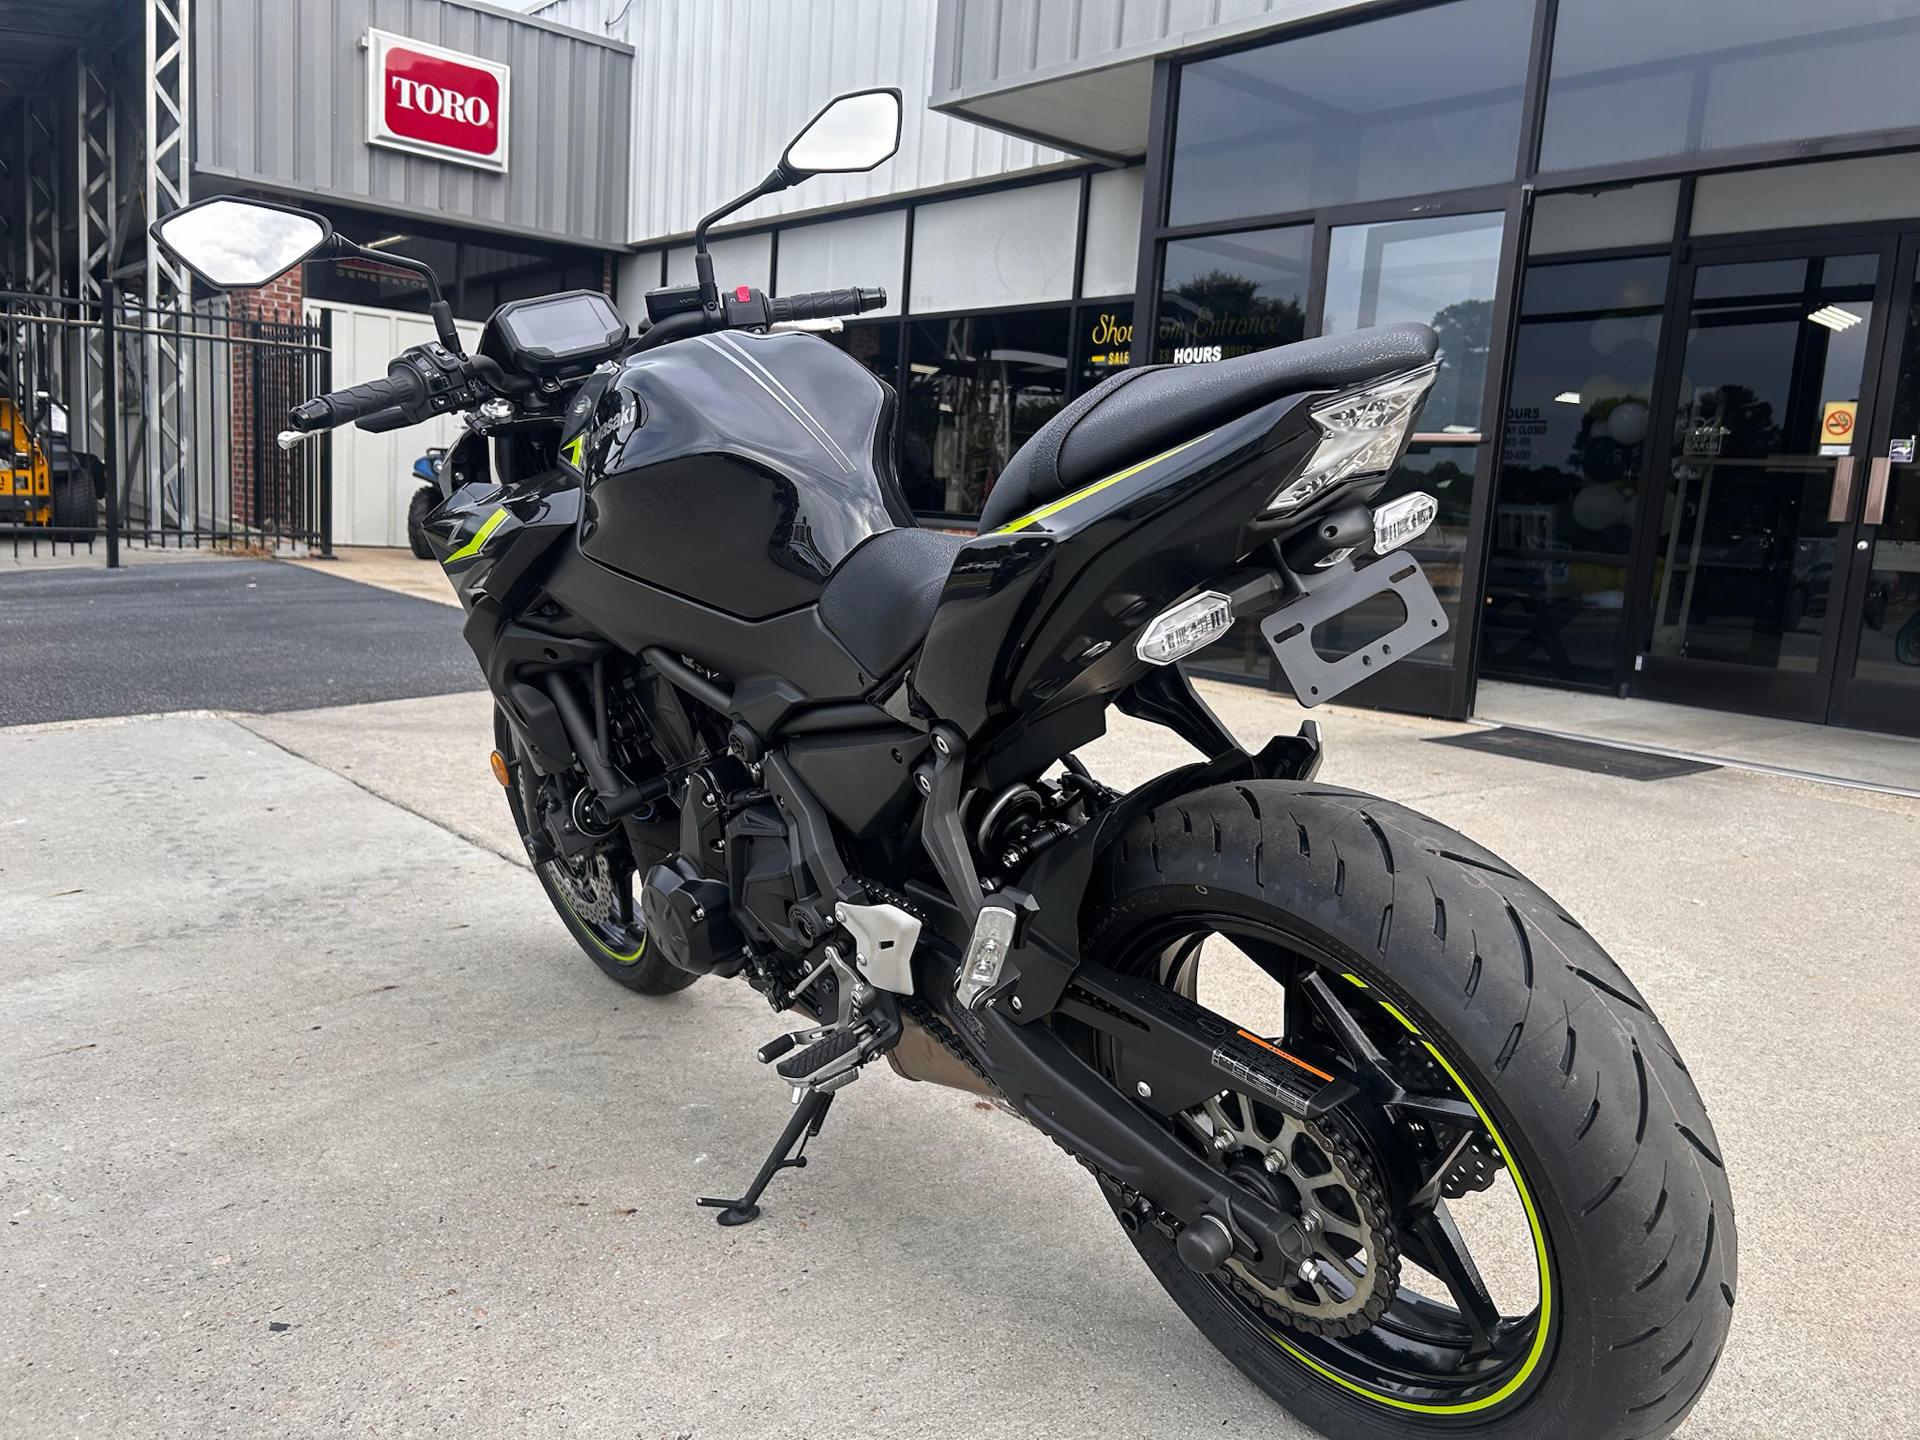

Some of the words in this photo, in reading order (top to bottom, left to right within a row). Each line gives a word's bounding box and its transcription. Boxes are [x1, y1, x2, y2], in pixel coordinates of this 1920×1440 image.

[392, 76, 490, 126] TORO
[1193, 306, 1281, 338] Entrance
[1108, 351, 1129, 365] SALE
[1173, 345, 1222, 364] HOURS
[1518, 425, 1547, 435] CLOSED
